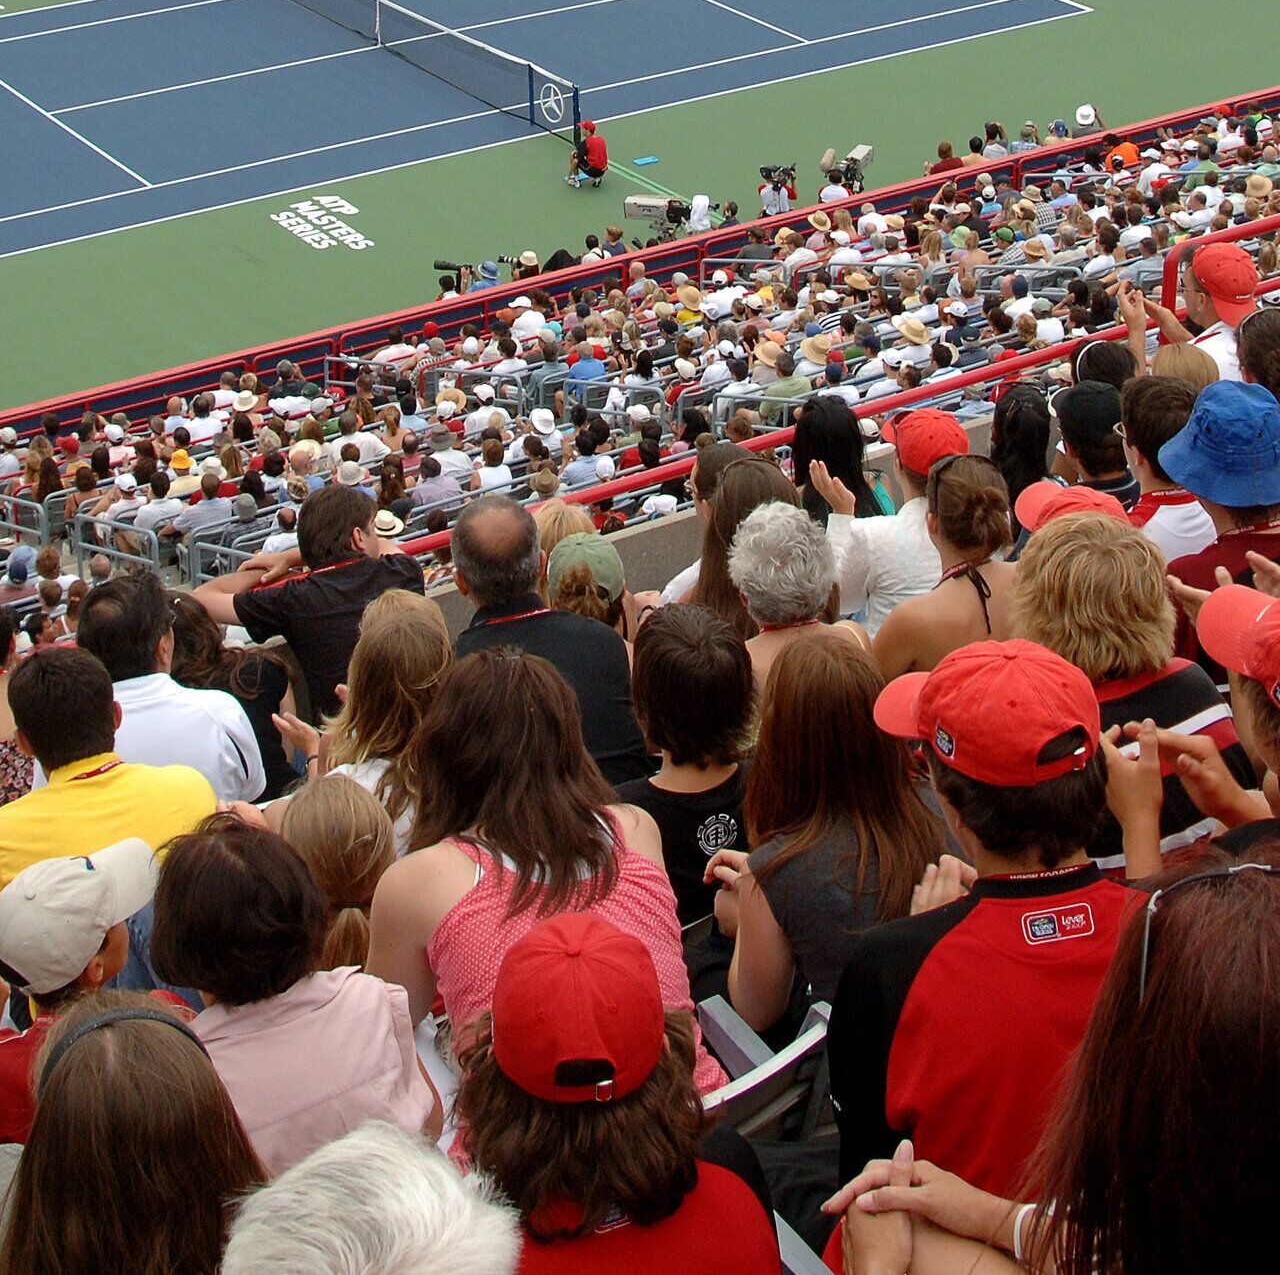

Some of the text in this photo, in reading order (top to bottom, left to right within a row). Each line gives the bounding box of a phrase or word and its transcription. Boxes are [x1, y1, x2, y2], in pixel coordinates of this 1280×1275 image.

[312, 195, 360, 215] ATP
[270, 211, 338, 250] SERIES
[290, 201, 375, 250] MASTERS
[1062, 913, 1084, 925] Lever
